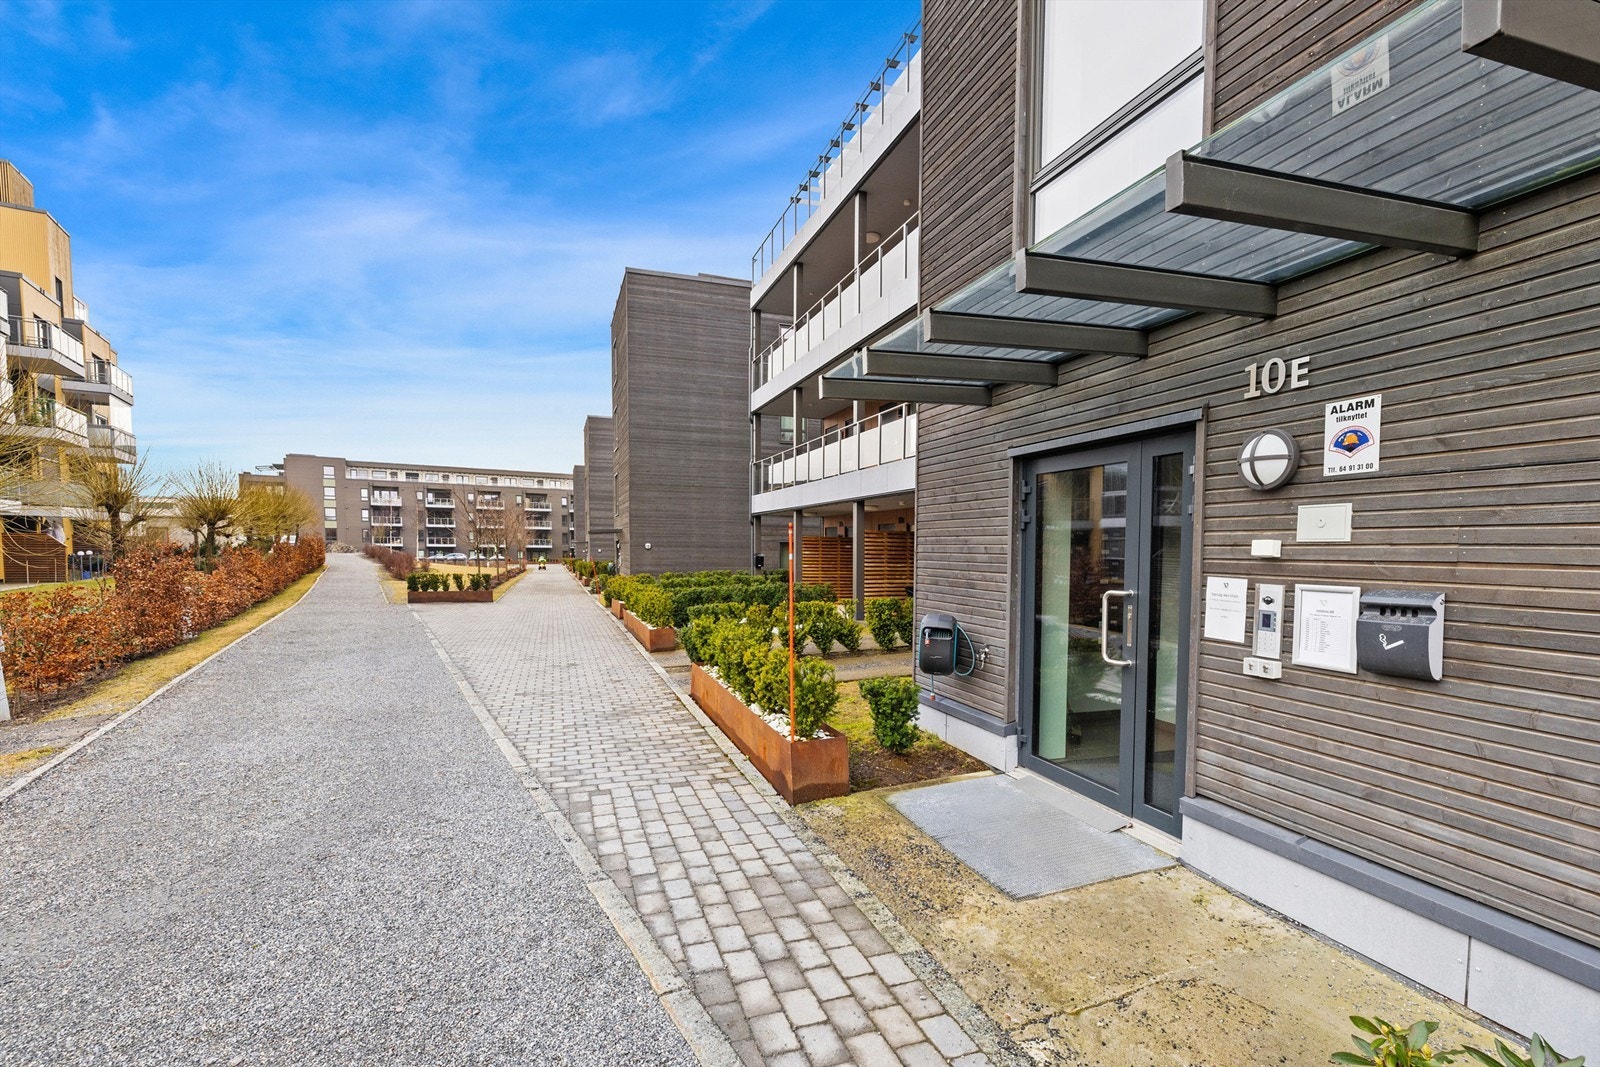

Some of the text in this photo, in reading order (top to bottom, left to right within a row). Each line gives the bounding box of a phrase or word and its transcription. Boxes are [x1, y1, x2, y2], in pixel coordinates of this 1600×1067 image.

[1244, 356, 1310, 399] 10E
[1330, 398, 1375, 415] ALARM
[1336, 412, 1368, 423] tilknyttet
